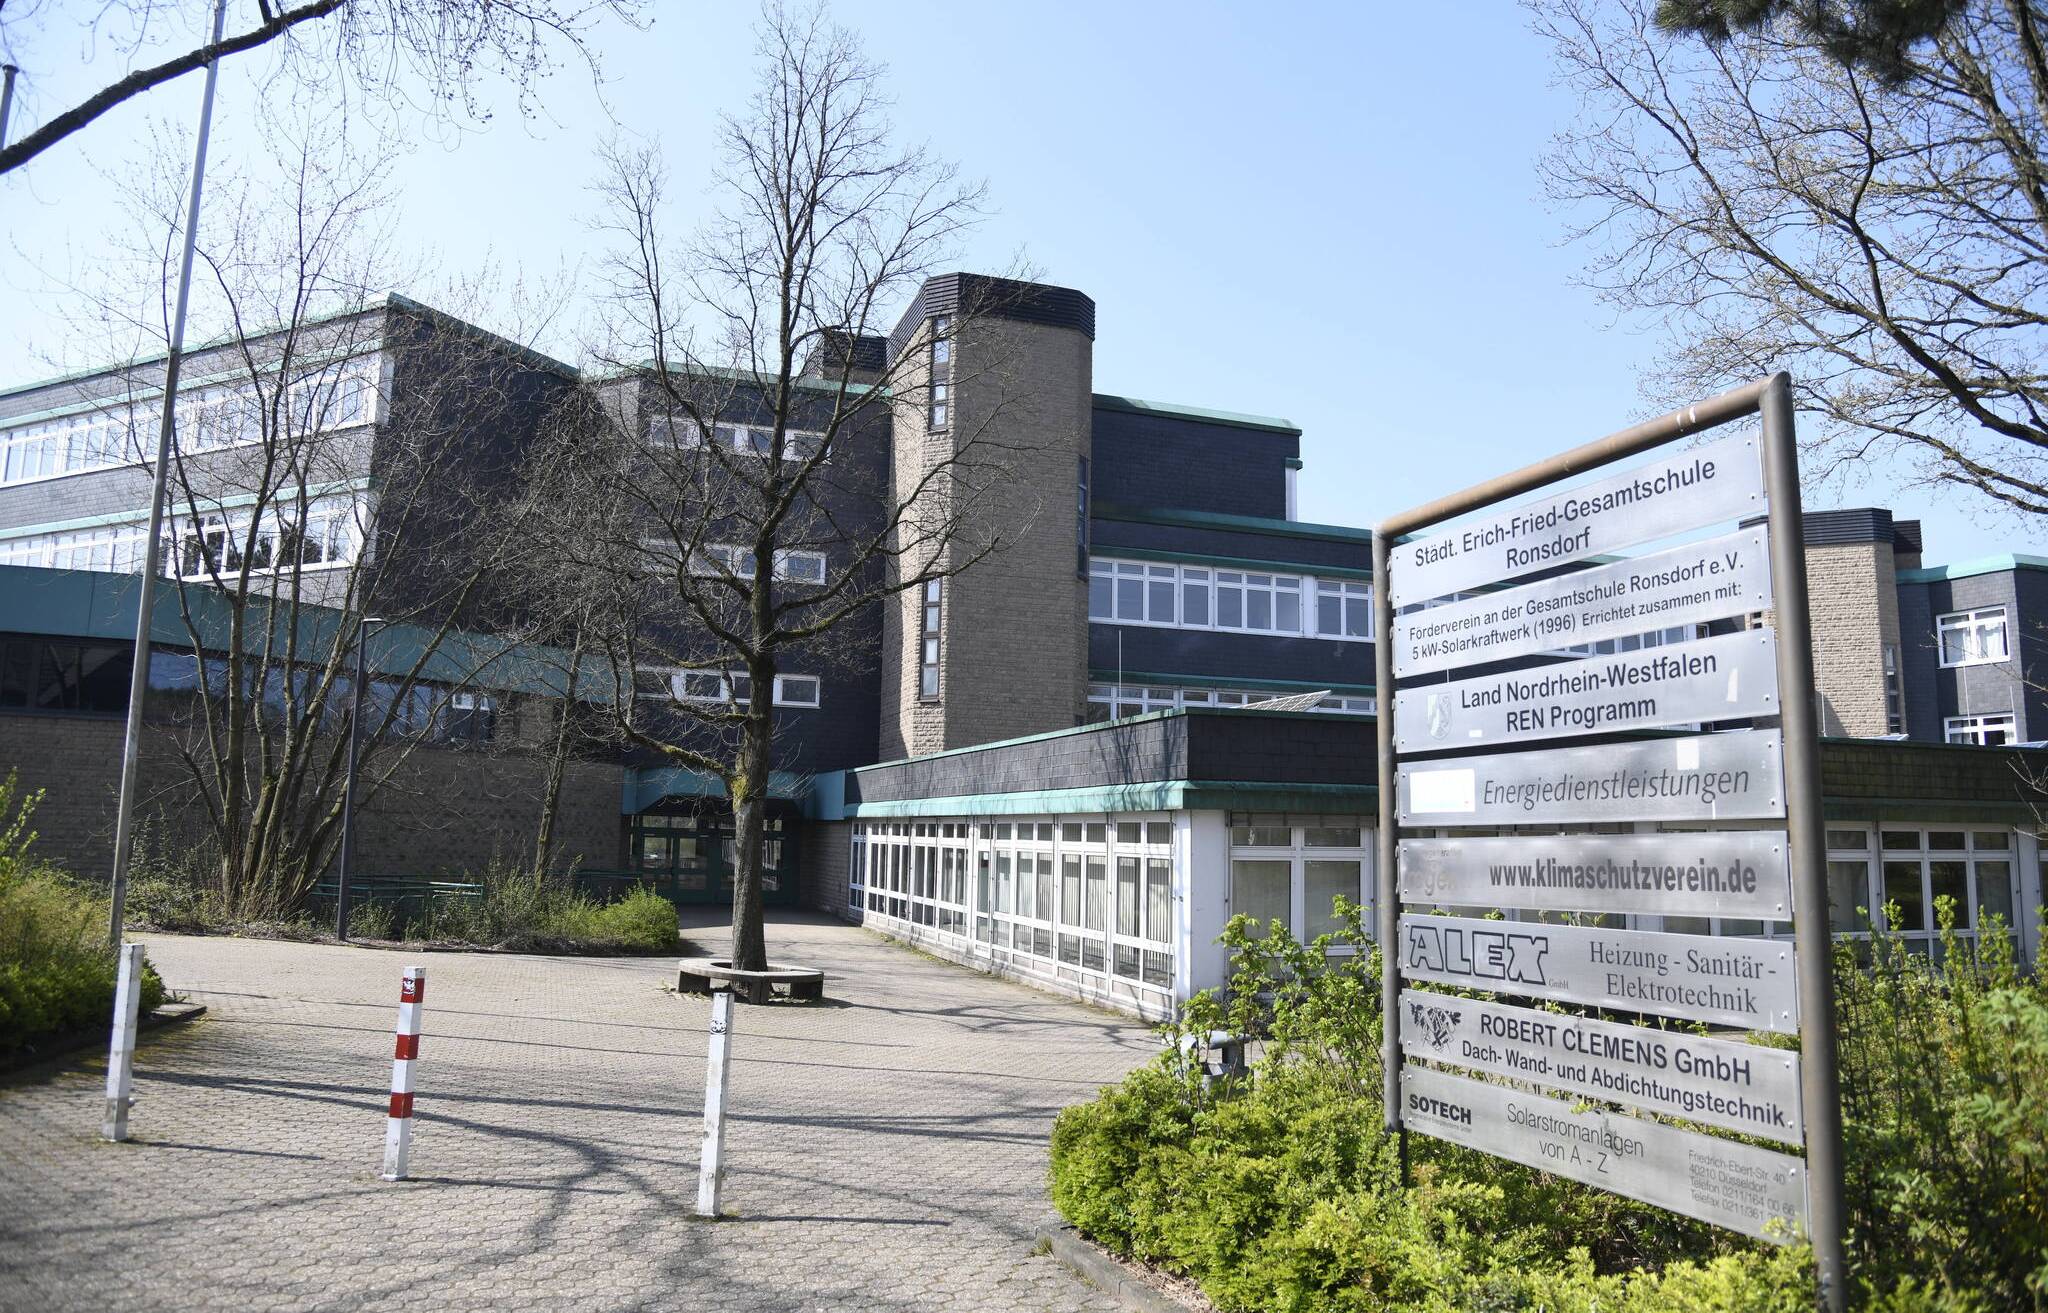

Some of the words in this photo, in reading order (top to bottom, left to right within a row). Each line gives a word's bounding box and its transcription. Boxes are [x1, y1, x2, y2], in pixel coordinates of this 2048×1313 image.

[1415, 539, 1458, 567] Städt.
[1463, 459, 1715, 553] Erich-Fried-Gesamtschule
[1506, 526, 1591, 569] Ronsdorf
[1484, 612, 1498, 625] an
[1502, 606, 1523, 621] der
[1526, 581, 1626, 615] Gesamtschule
[1630, 559, 1705, 593] Ronsdorf
[1709, 551, 1744, 575] e.V.
[1412, 646, 1419, 660] 5
[1421, 623, 1531, 658] kW-Solarkraftwerk
[1533, 613, 1576, 640] (1996)
[1582, 603, 1636, 627] Errichtet
[1638, 591, 1710, 615] zusammen
[1715, 582, 1742, 599] mit:
[1461, 684, 1501, 709] Land
[1506, 653, 1717, 703] Nordrhein-Westfalen
[1507, 708, 1544, 733] REN
[1551, 698, 1656, 729] Programm
[1484, 768, 1750, 811] Energiedienstleistungen
[1489, 857, 1757, 894] www.klimaschutzverein.de
[1409, 925, 1549, 985] ALEX
[1590, 941, 1669, 976] Heizung
[1606, 973, 1758, 1014] Elektrotechnik
[1480, 1013, 1557, 1048] ROBERT
[1562, 1028, 1667, 1069] CLEMENS
[1674, 1048, 1751, 1086] GmbH
[1462, 1040, 1502, 1063] Dach-
[1505, 1049, 1553, 1074] Wand-
[1557, 1064, 1586, 1083] und
[1591, 1067, 1785, 1128] Abdichtungstechnik
[1409, 1094, 1472, 1125] SOTECH
[1507, 1103, 1644, 1159] Solarstromanlagen
[1539, 1140, 1565, 1161] von
[1570, 1145, 1581, 1166] A
[1597, 1153, 1608, 1174] Z
